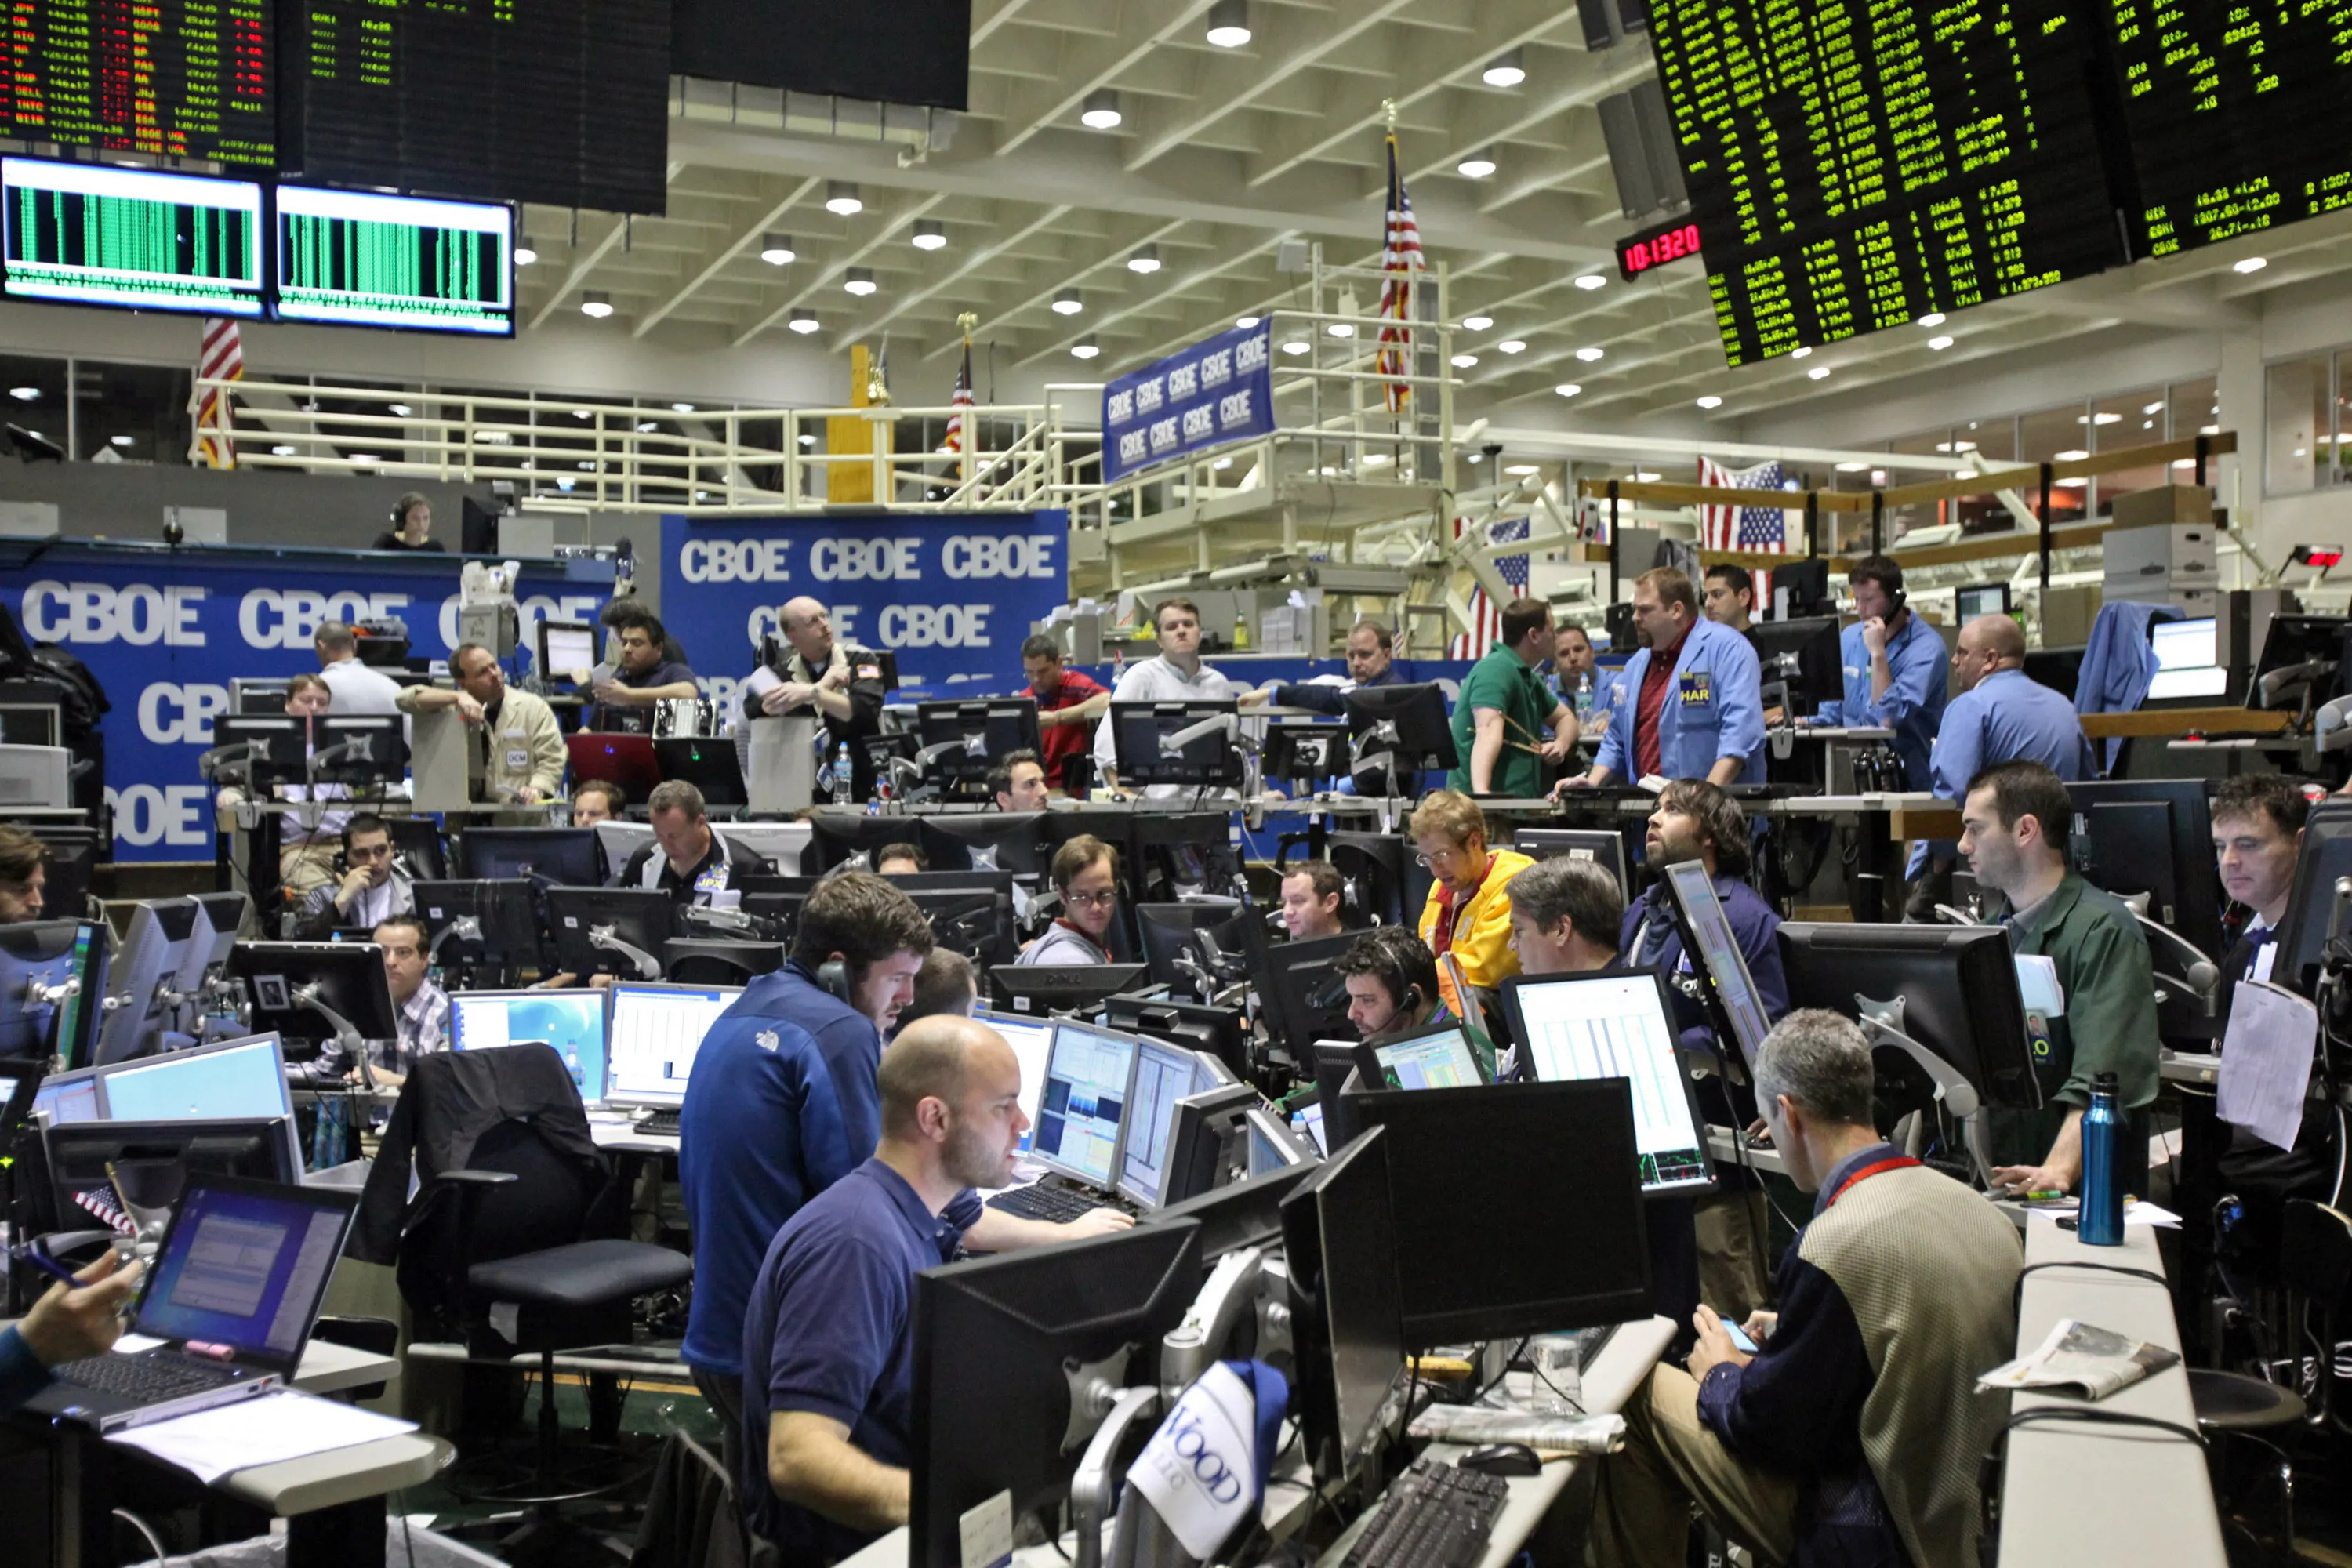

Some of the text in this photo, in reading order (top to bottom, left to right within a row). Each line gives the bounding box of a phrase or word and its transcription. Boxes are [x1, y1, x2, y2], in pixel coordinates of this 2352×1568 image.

[1108, 333, 1269, 421] CBOE CBOE CBOE CBOE CBOE
[1120, 389, 1251, 459] CBOE CBOE CBOE CBOE
[680, 535, 1055, 583] CBOE CBOE CBOE
[22, 580, 207, 646] CBOE
[439, 593, 596, 652] COE
[748, 604, 991, 648] CE CBOE
[138, 682, 229, 744] CB
[1680, 689, 1709, 702] HAR
[103, 783, 207, 846] OE
